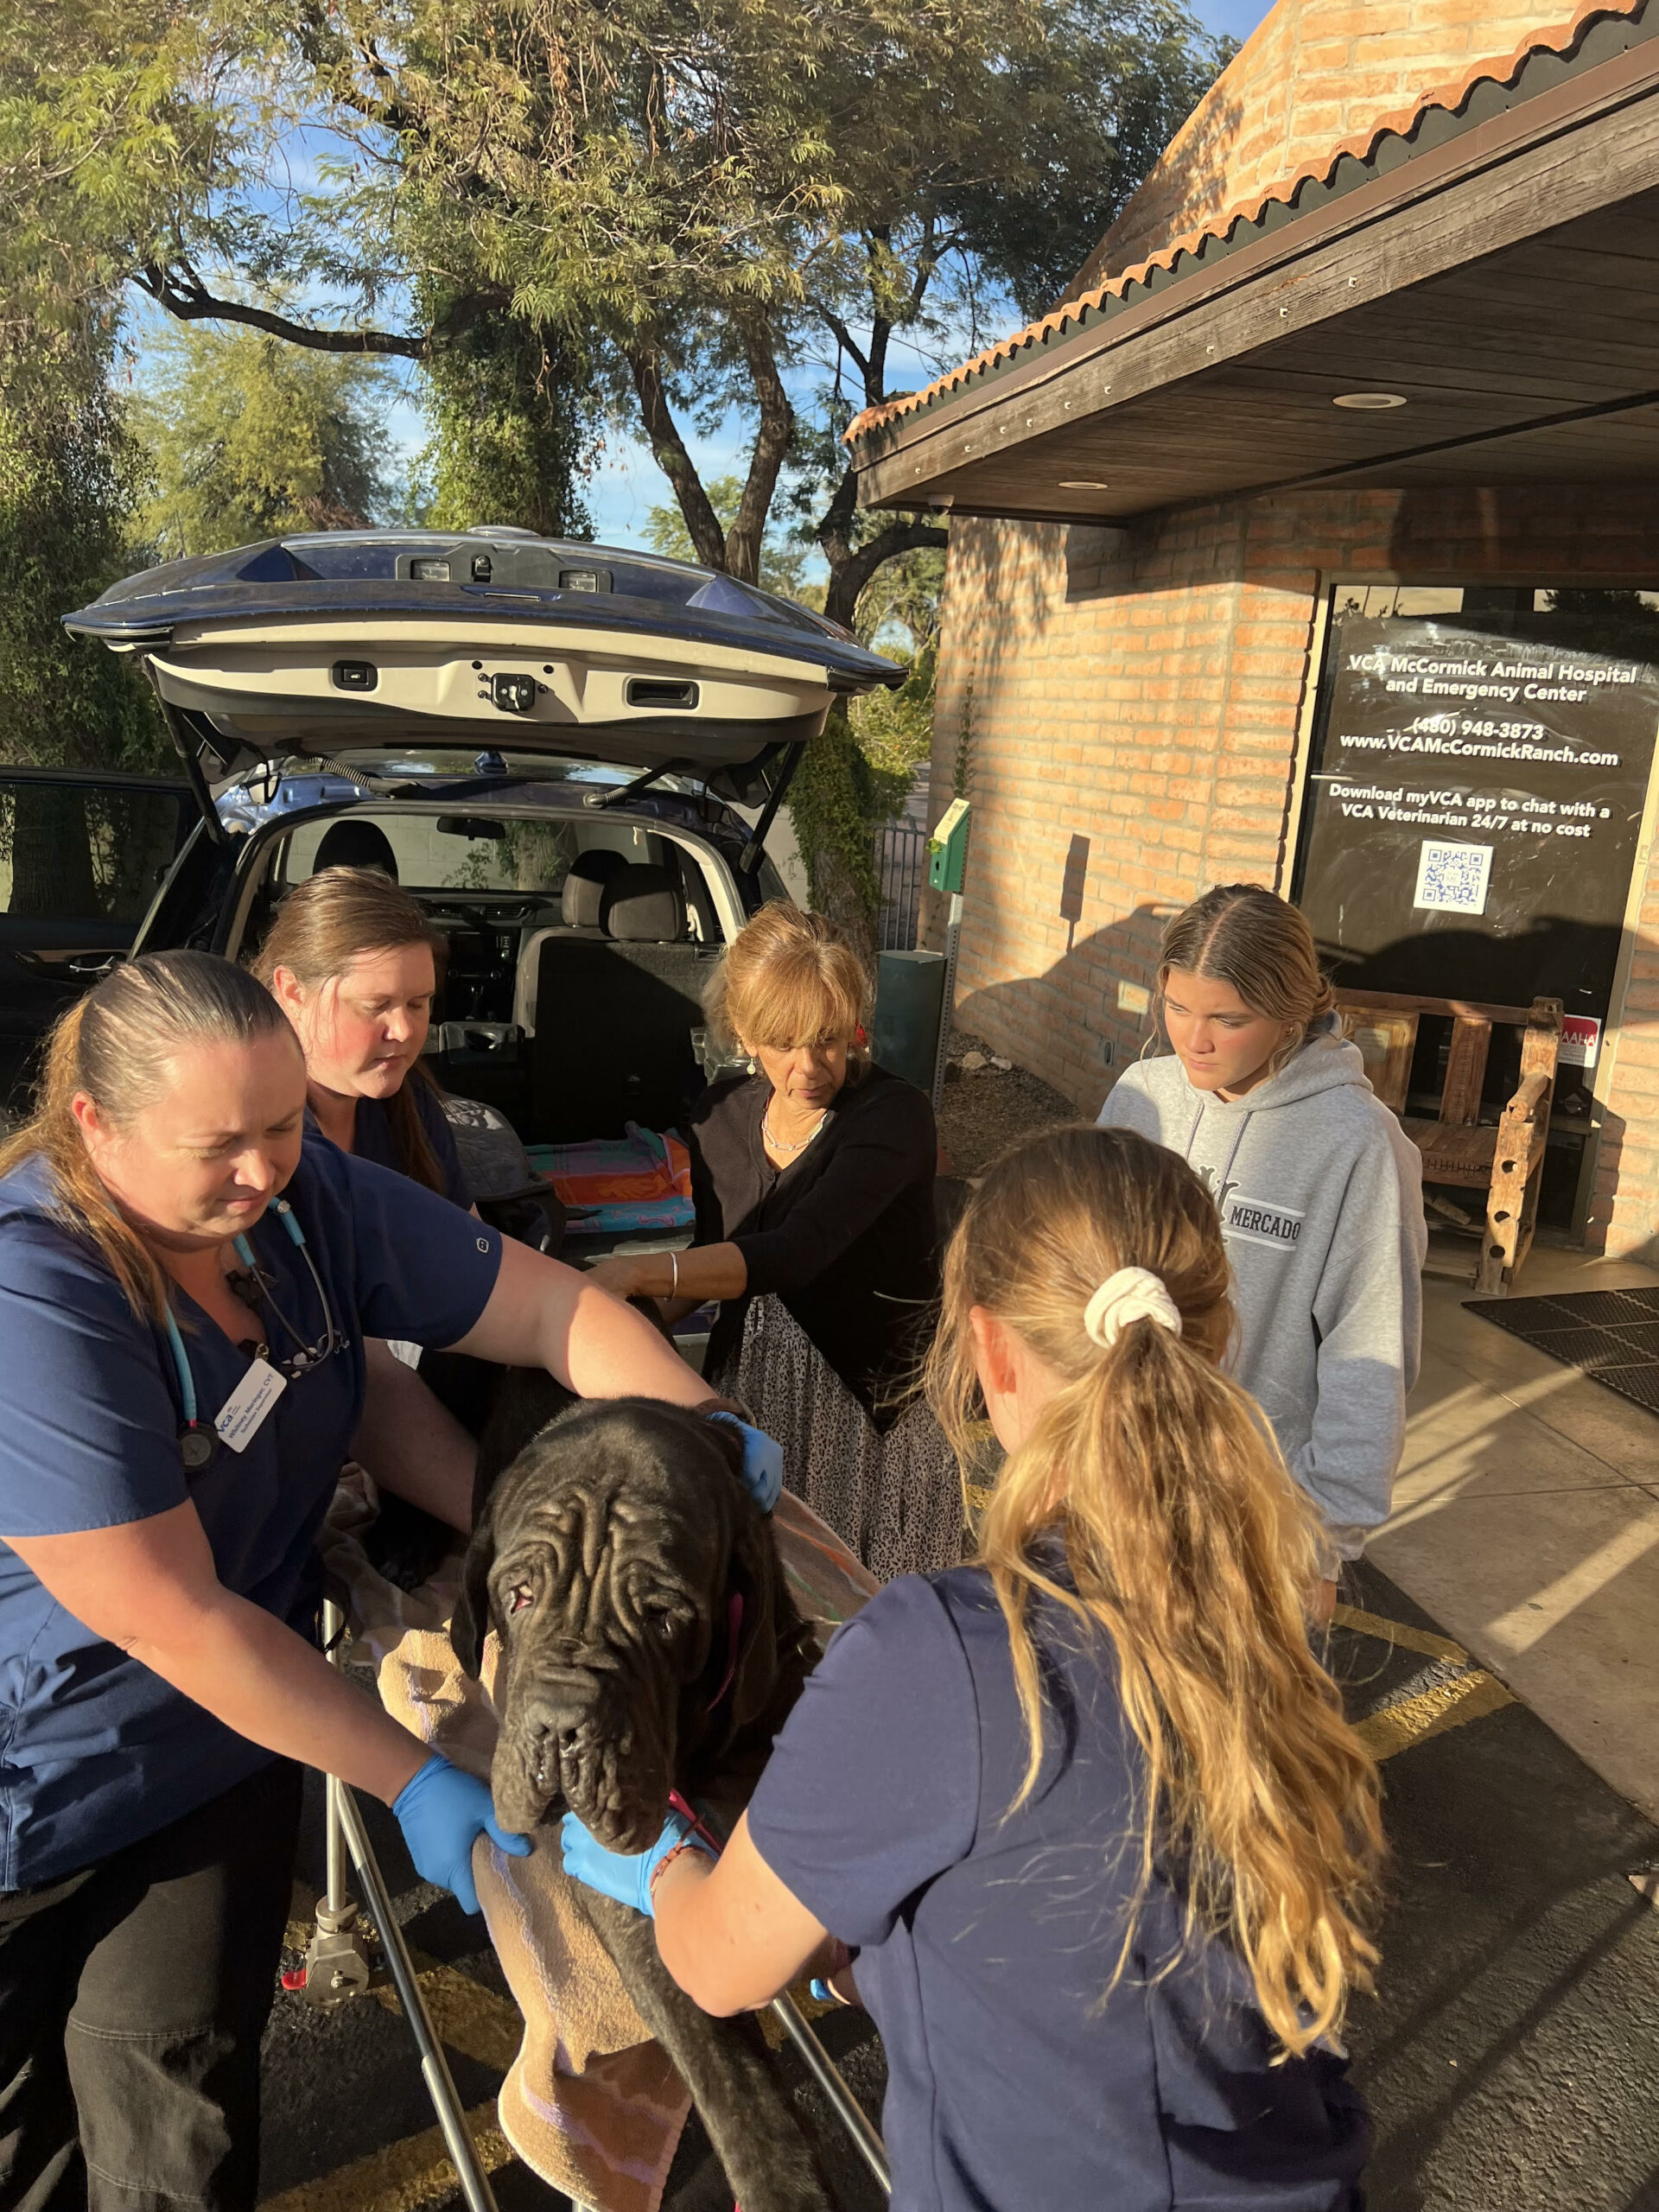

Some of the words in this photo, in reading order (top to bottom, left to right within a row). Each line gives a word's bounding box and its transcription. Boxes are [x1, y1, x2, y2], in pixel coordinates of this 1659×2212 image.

[1350, 654, 1386, 671] VCA
[1390, 657, 1488, 677] McCormick
[1491, 661, 1554, 679] Animal
[1558, 664, 1637, 686] Hospital
[1386, 677, 1418, 693] and
[1422, 678, 1520, 702] Emergency
[1523, 683, 1586, 702] Center
[1413, 716, 1456, 737] (480)
[1461, 721, 1544, 741] 948-3873
[1340, 734, 1619, 766] www.VCAMcCormickRanch.com
[1329, 783, 1404, 802] Download
[1406, 791, 1463, 807] myVCA
[1465, 797, 1497, 812] app
[1500, 798, 1518, 810] to
[1522, 798, 1557, 814] chat
[1560, 802, 1597, 817] with
[1599, 807, 1611, 818] a
[1341, 803, 1374, 818] VCA
[1378, 805, 1468, 826] Veterinarian
[1471, 814, 1510, 830] 24/7
[1511, 819, 1529, 832] at
[1531, 822, 1553, 834] no
[1555, 823, 1592, 837] cost
[1561, 1031, 1596, 1046] AAHA
[1229, 1205, 1301, 1241] MERCADO
[264, 1373, 274, 1387] CVT
